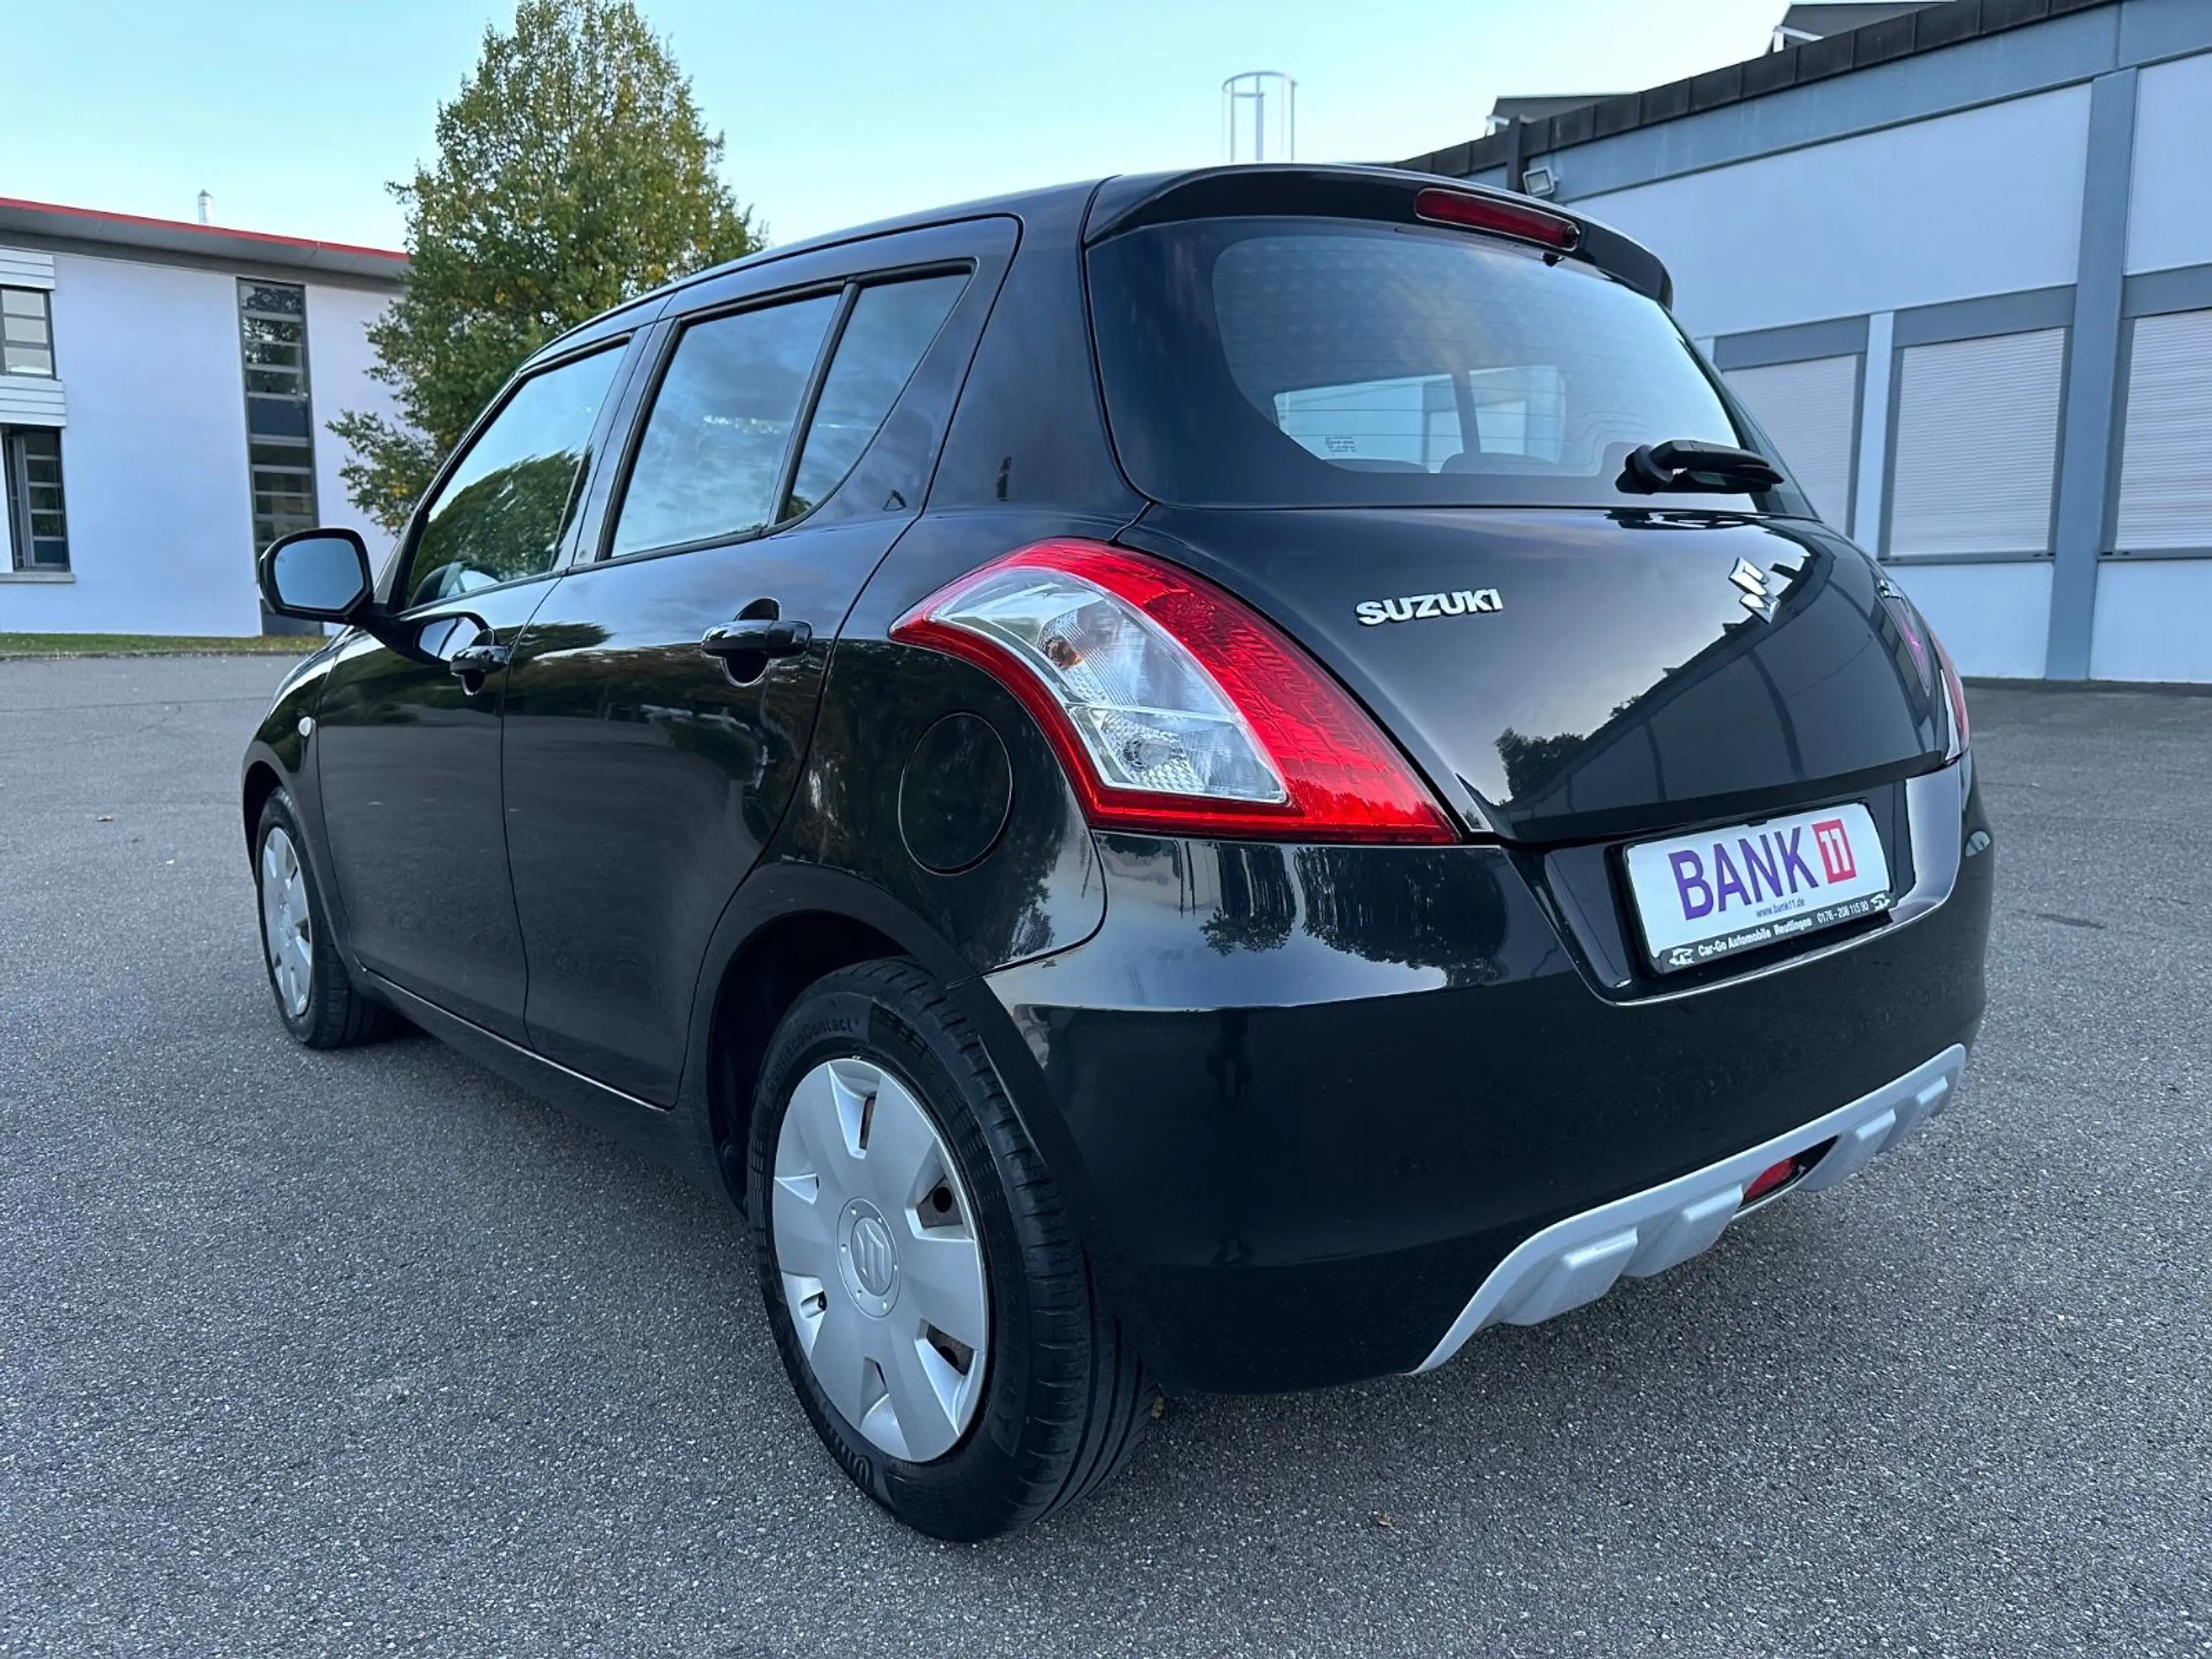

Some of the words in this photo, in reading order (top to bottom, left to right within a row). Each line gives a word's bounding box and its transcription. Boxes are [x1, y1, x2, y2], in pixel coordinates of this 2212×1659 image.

[1356, 588, 1504, 627] SUZUKI
[1668, 826, 1819, 921] BANK
[1819, 826, 1853, 877] 11
[1698, 940, 1728, 957] Car-Go
[1728, 927, 1772, 950] Automobile
